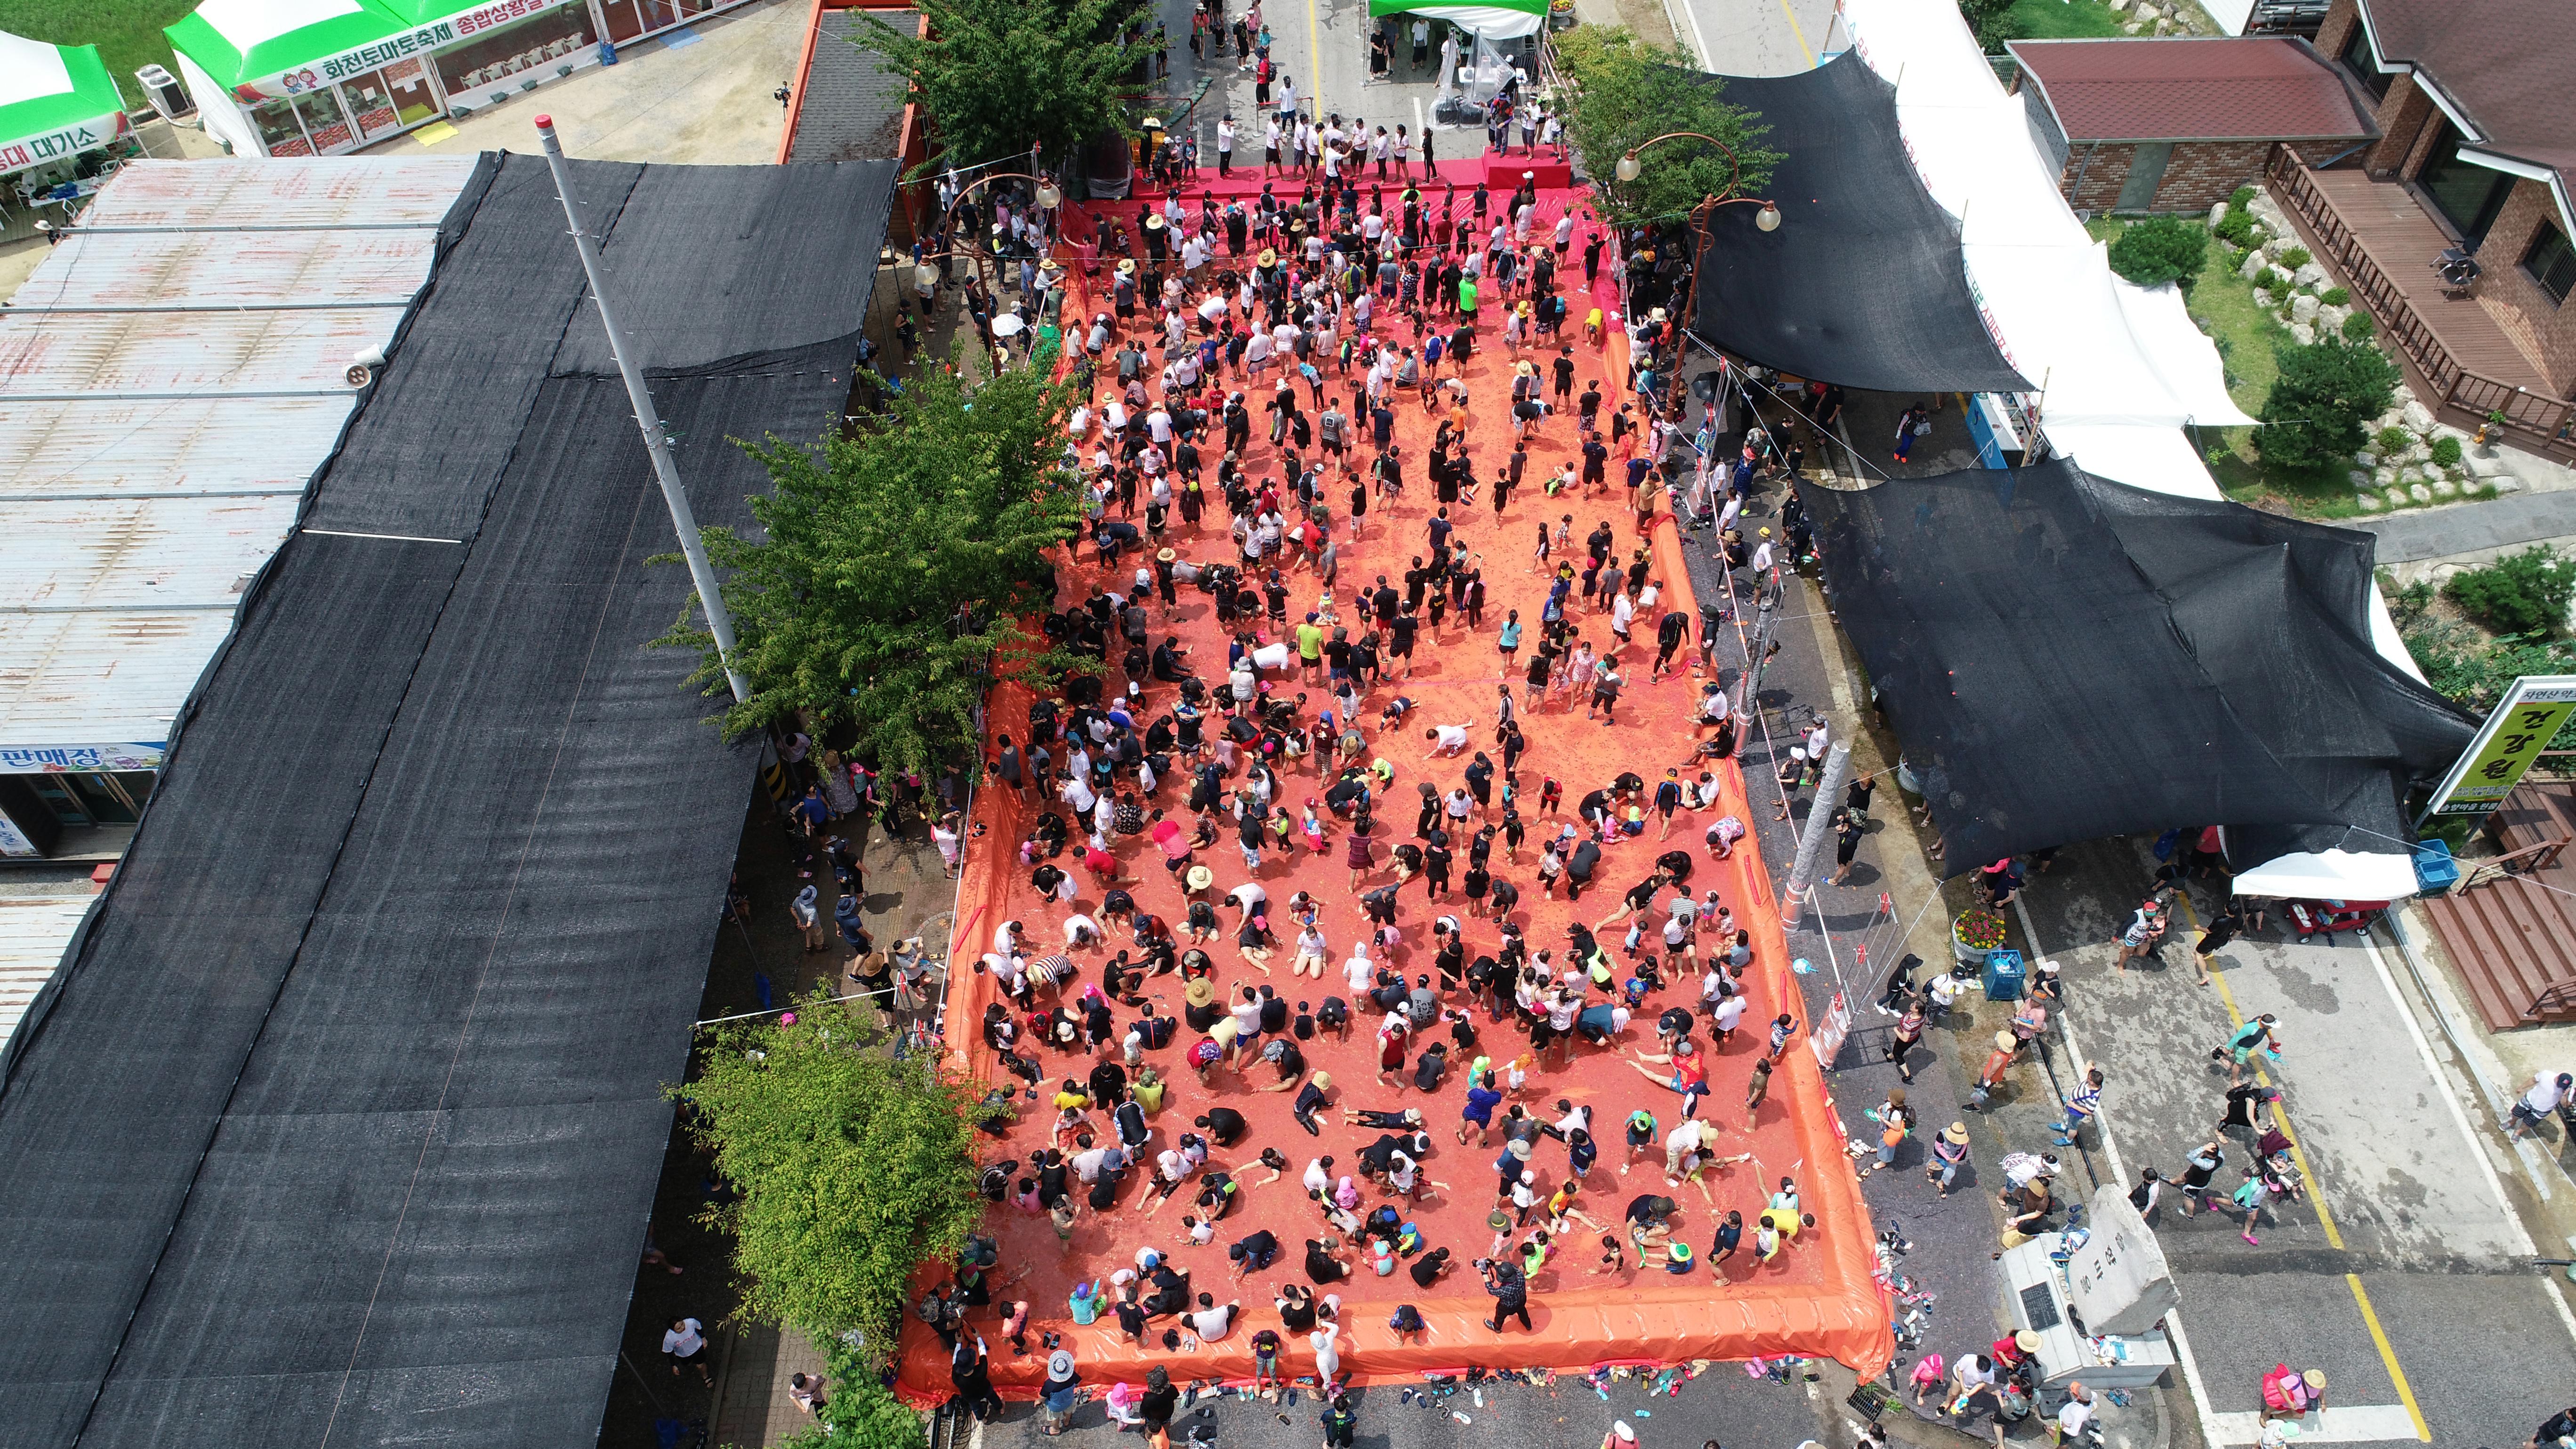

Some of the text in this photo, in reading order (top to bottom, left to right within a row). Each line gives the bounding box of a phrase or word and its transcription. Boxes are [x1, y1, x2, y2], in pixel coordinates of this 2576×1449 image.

[322, 0, 544, 80] 화천토마토축제 종합상황실
[30, 128, 99, 159] 대기소
[2524, 690, 2559, 699] 자연산
[0, 748, 101, 767] 판매장
[2481, 710, 2556, 780] 건강원
